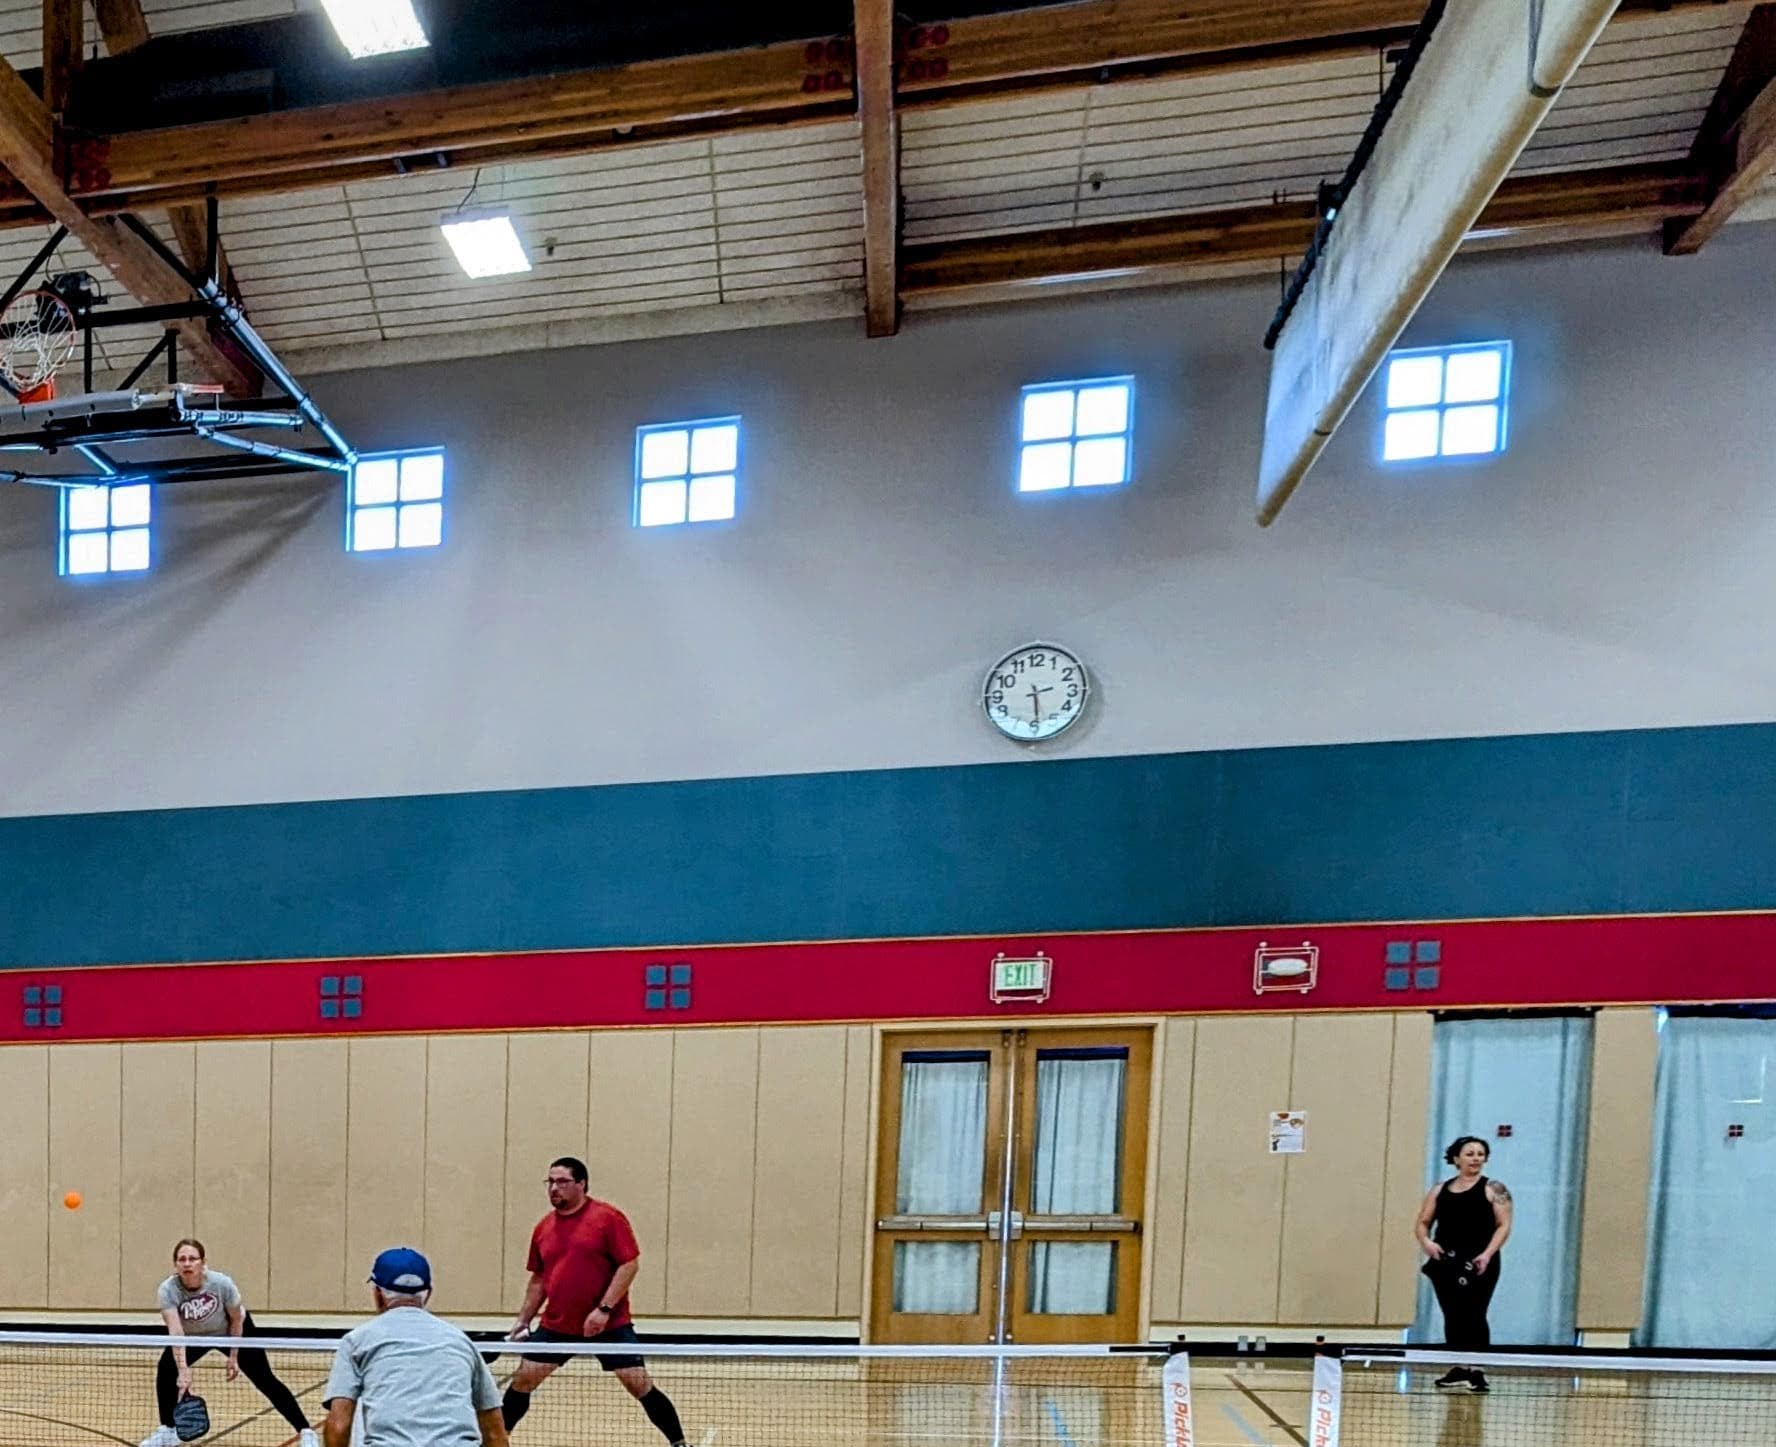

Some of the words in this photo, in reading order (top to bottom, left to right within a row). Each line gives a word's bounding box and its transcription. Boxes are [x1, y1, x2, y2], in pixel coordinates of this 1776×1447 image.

[1011, 660, 1025, 674] 11
[1027, 653, 1045, 667] 12
[1049, 657, 1057, 670] 1
[997, 674, 1016, 688] 10
[1061, 667, 1073, 681] 2
[992, 690, 1003, 703] 9
[1067, 684, 1078, 697] 3
[1061, 700, 1072, 712] 4
[1004, 963, 1037, 987] EXIT
